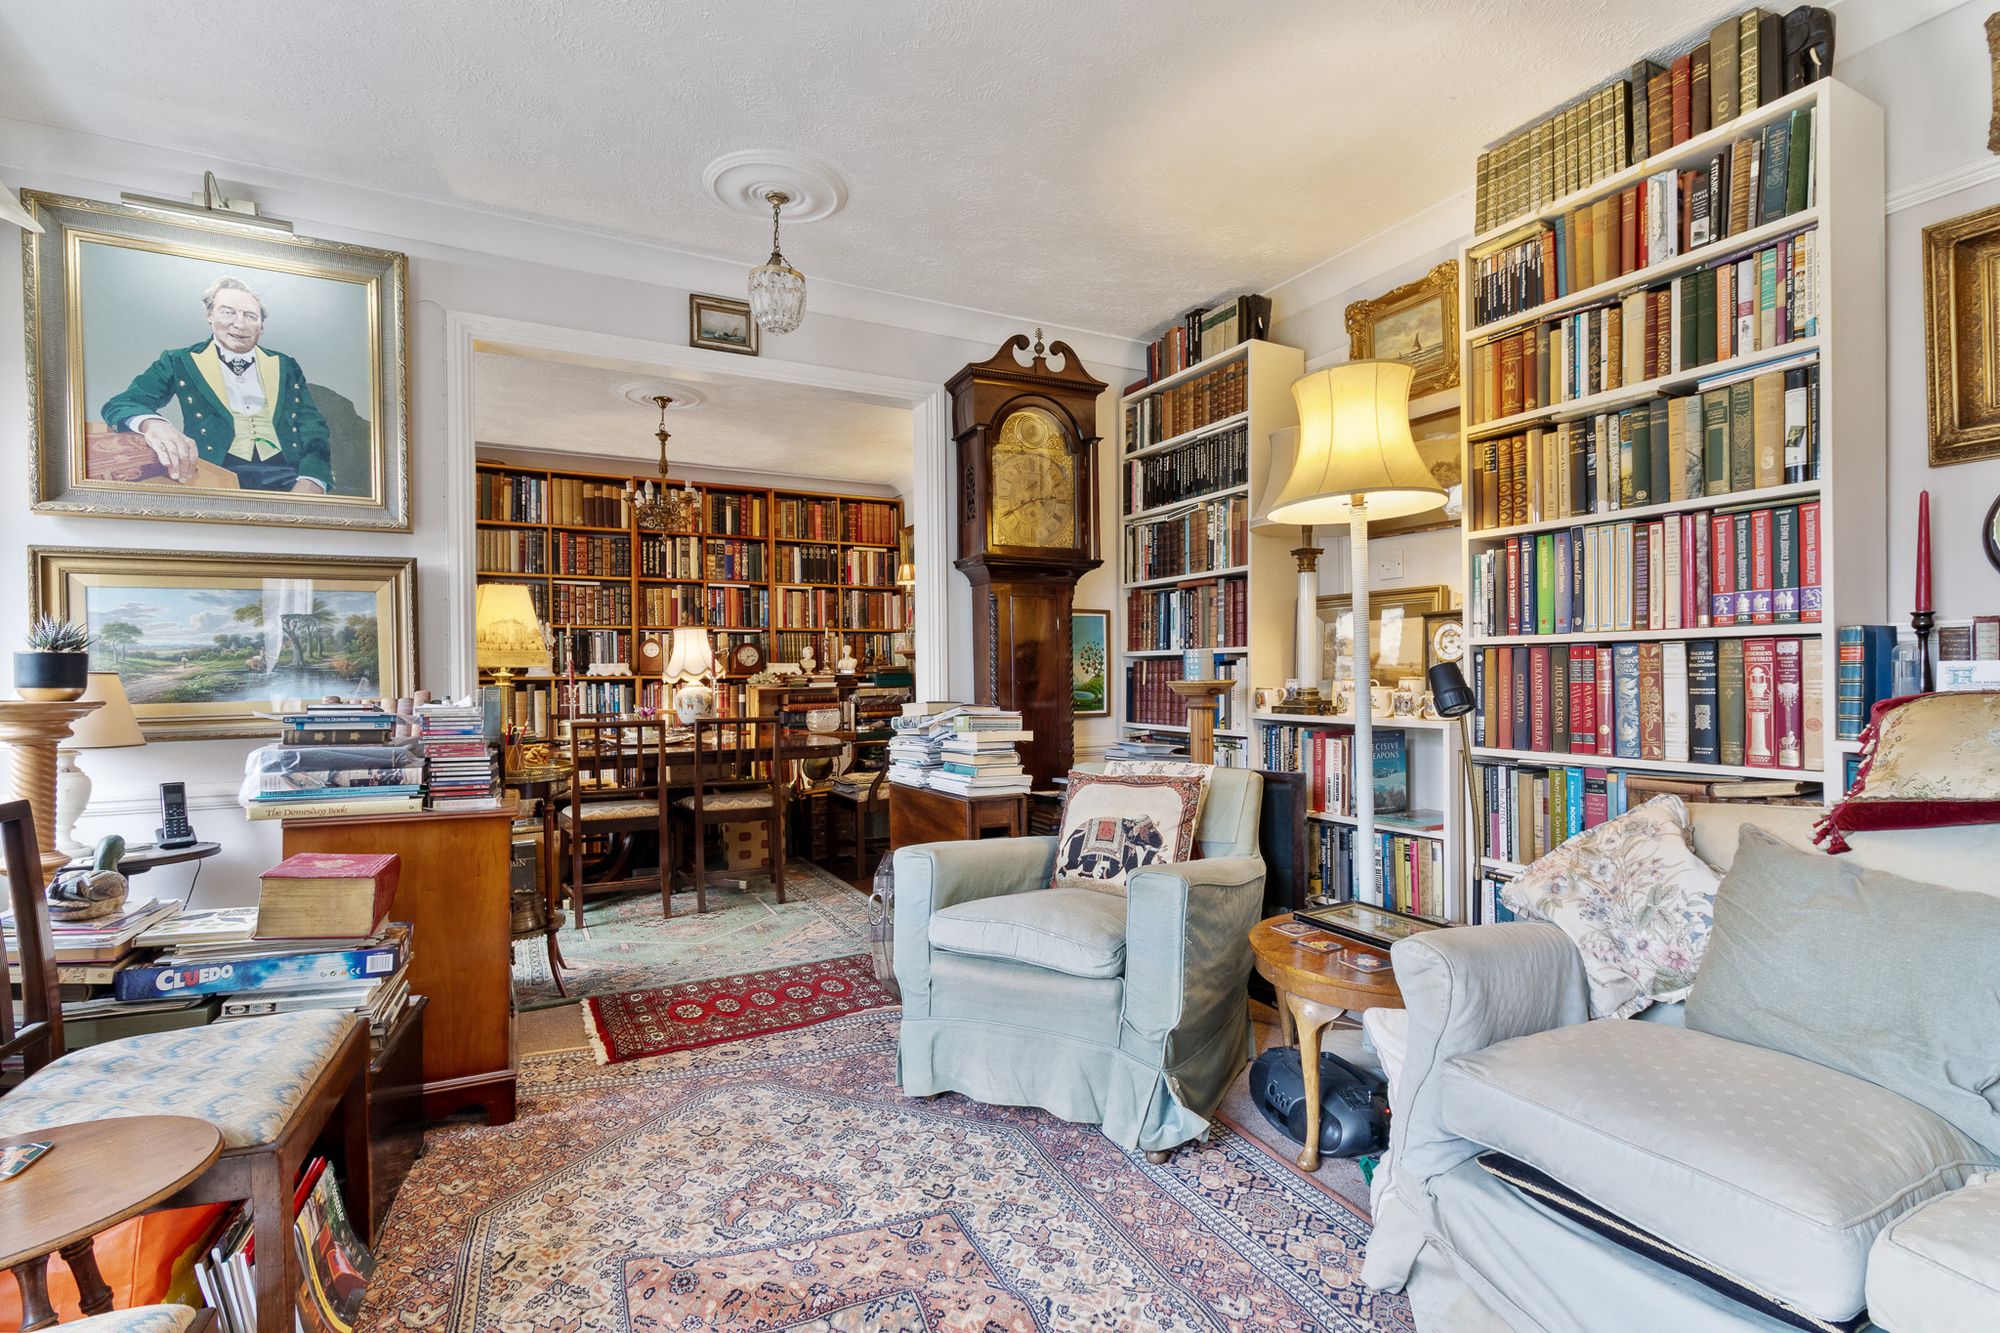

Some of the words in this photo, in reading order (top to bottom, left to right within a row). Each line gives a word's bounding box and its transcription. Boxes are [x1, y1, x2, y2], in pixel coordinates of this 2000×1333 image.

[1710, 164, 1719, 194] TITANIC
[1610, 447, 1620, 482] PASSAGES
[1636, 540, 1648, 588] SAGITTARIUS
[1509, 580, 1515, 589] TO
[1636, 590, 1648, 615] RISING
[1534, 652, 1543, 701] ALEXANDER
[1554, 666, 1563, 697] JULIUS
[1534, 702, 1543, 718] THE
[1554, 698, 1563, 734] CAESAR
[1534, 719, 1543, 746] GREAT
[1372, 742, 1399, 751] ECISIVE
[1372, 751, 1400, 759] EAPONS
[266, 809, 282, 817] The
[283, 806, 326, 817] Domesday
[328, 805, 348, 814] Book
[155, 964, 234, 991] CLUEDO
